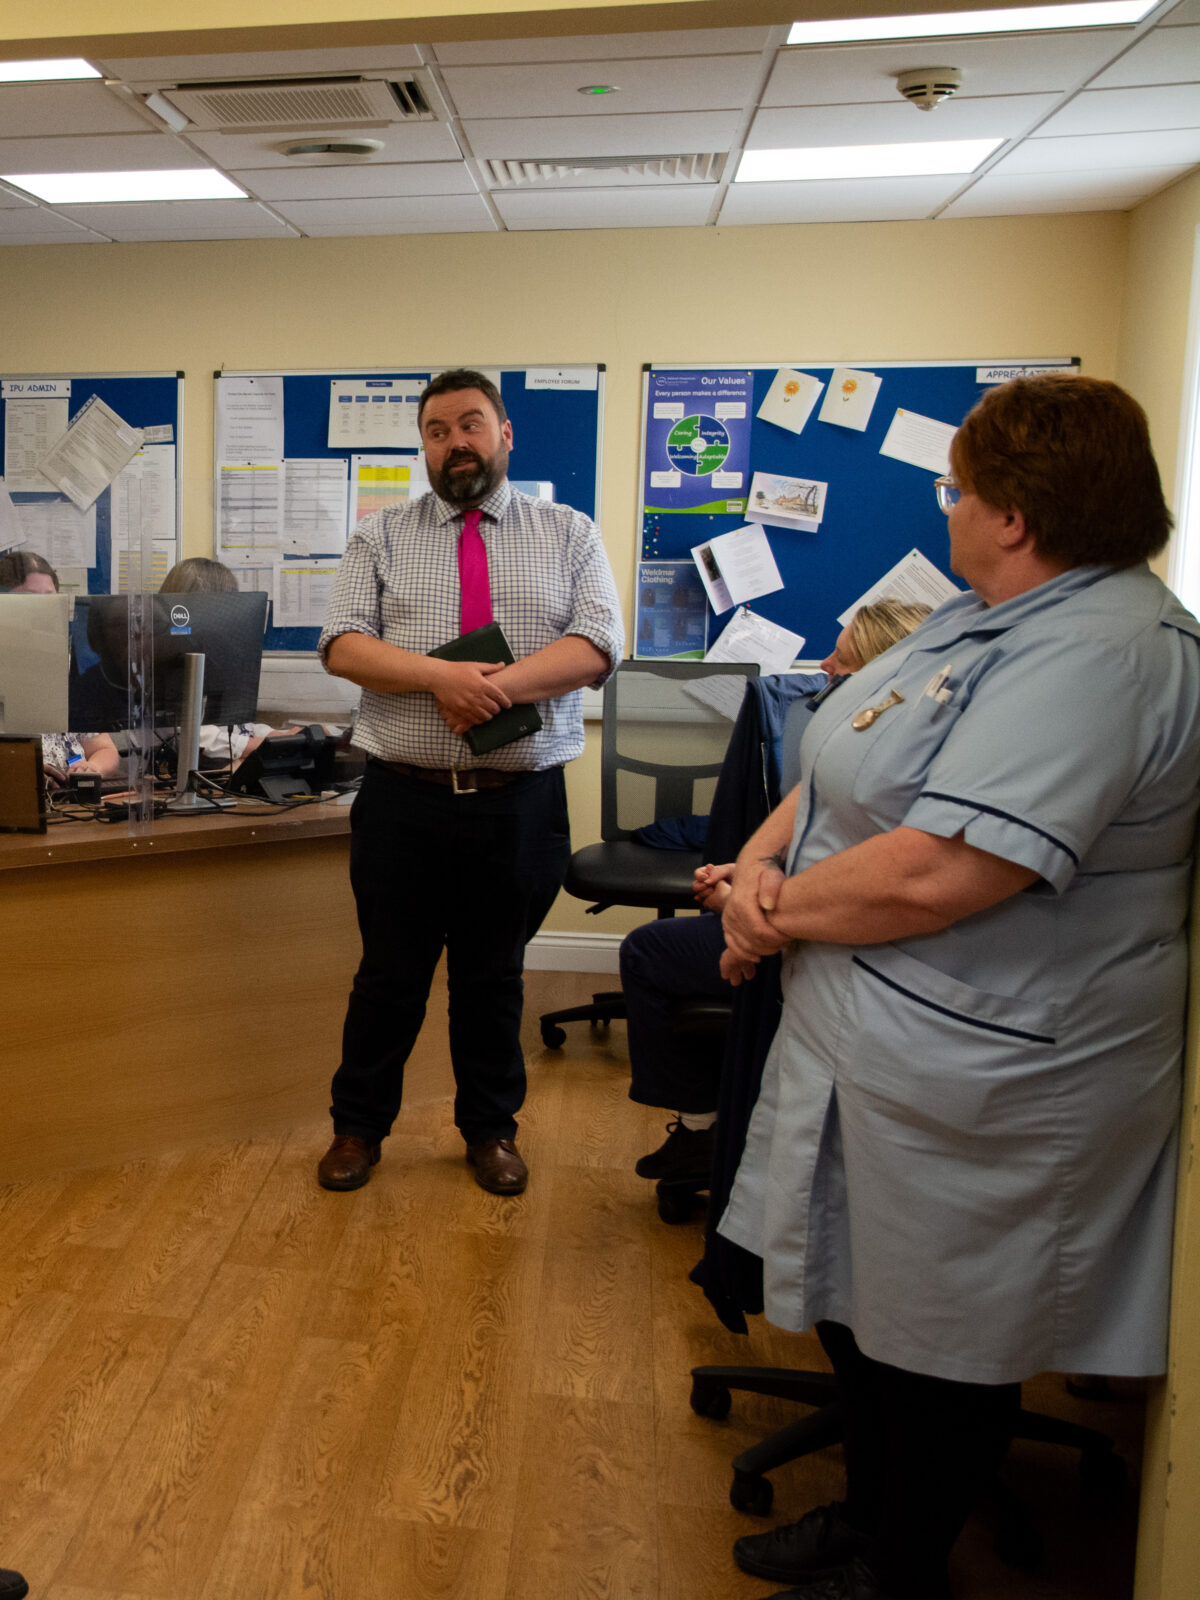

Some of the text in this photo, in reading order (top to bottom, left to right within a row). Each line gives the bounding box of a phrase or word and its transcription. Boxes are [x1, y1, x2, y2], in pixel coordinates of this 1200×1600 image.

[701, 376, 717, 385] Our
[718, 376, 746, 385] Values
[9, 384, 57, 392] IPU ADMIN
[655, 390, 670, 398] Every
[717, 389, 746, 397] difference
[641, 568, 676, 576] Weldmar
[641, 576, 673, 585] Clothing
